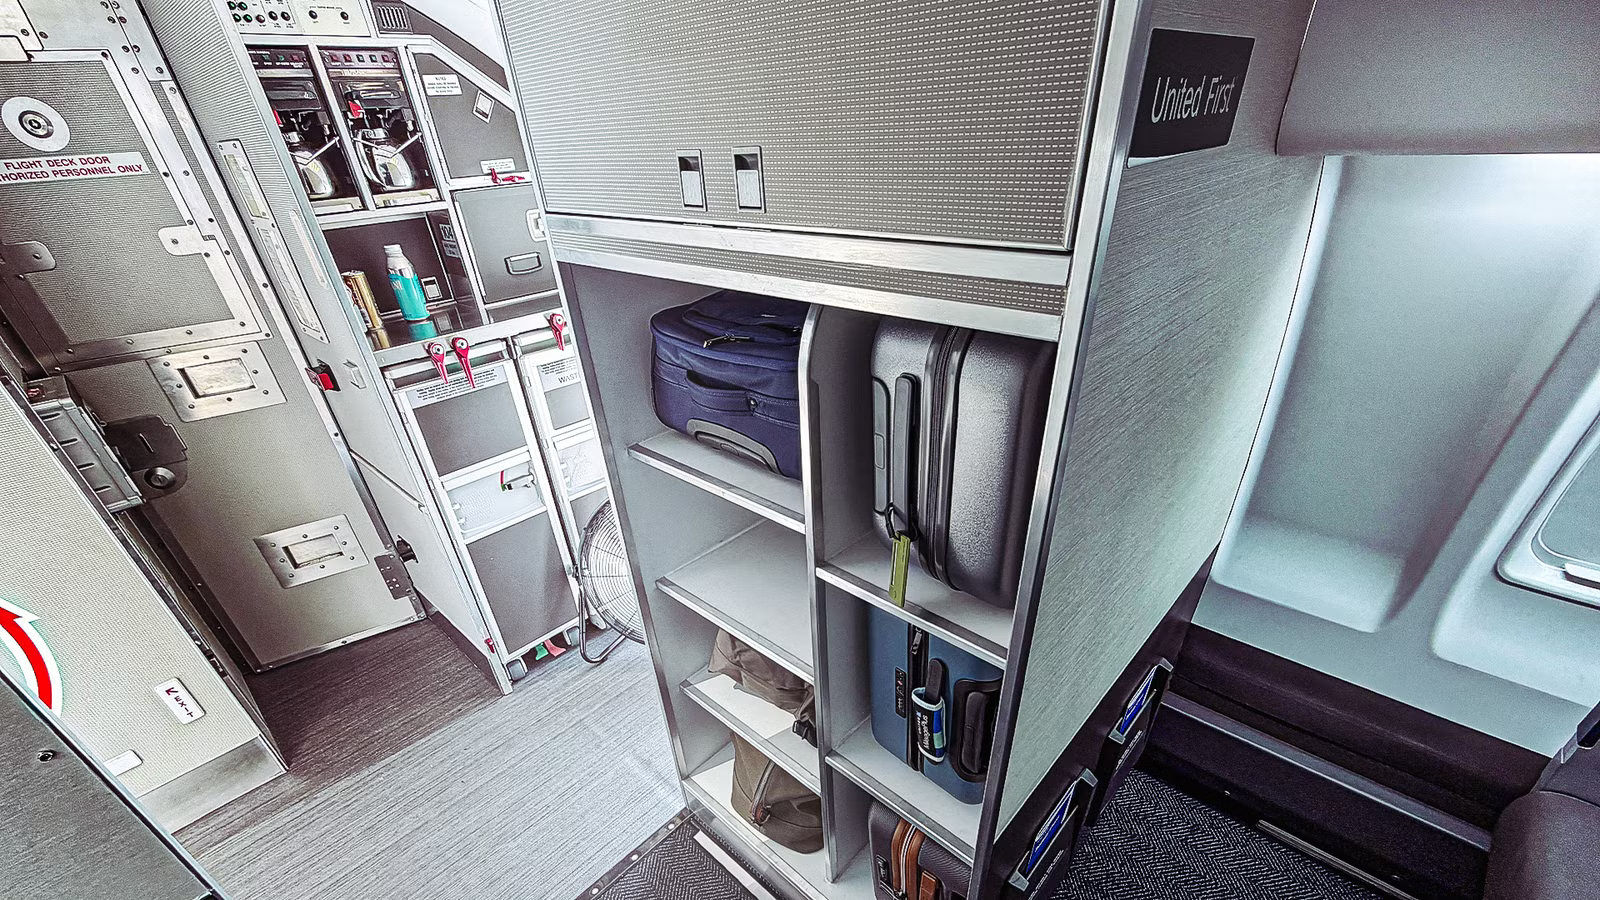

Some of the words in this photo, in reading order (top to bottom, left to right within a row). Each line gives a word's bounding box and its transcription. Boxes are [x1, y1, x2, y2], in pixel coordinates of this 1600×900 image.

[1151, 75, 1206, 123] United
[1203, 75, 1235, 115] First
[3, 160, 43, 171] FLIGHT
[45, 158, 77, 168] DECK
[78, 156, 111, 166] DOOR
[51, 166, 116, 178] PERSONNEL
[117, 164, 143, 173] ONLY
[174, 695, 194, 718] EXIT
